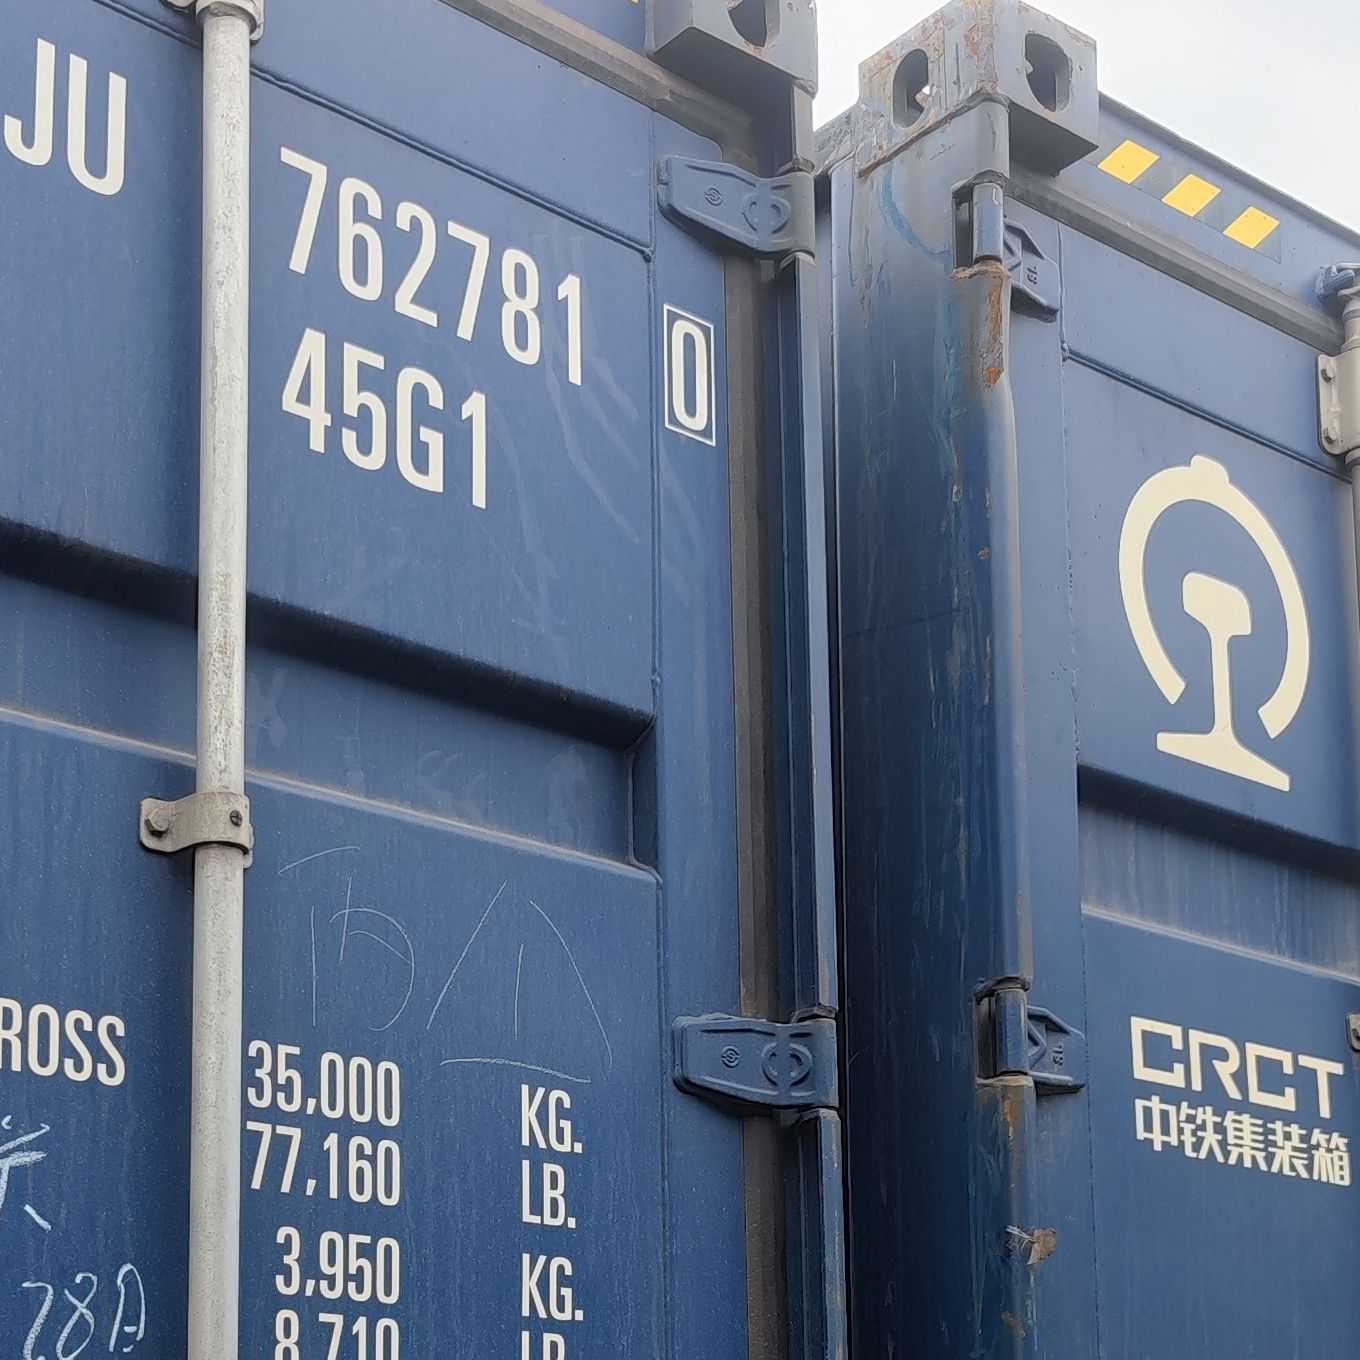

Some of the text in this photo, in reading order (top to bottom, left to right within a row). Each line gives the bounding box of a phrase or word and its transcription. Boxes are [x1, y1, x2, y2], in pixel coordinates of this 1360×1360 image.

[280, 146, 582, 386] 762781
[281, 327, 487, 509] 45G1
[247, 1039, 401, 1127] 35,000
[520, 1083, 583, 1154] KG.
[1130, 1016, 1345, 1119] CRCT
[246, 1120, 577, 1229] 77,160 LB.
[1134, 1095, 1352, 1186] 中铁集装箱
[275, 1225, 401, 1305] 3,950
[520, 1252, 584, 1322] KG.
